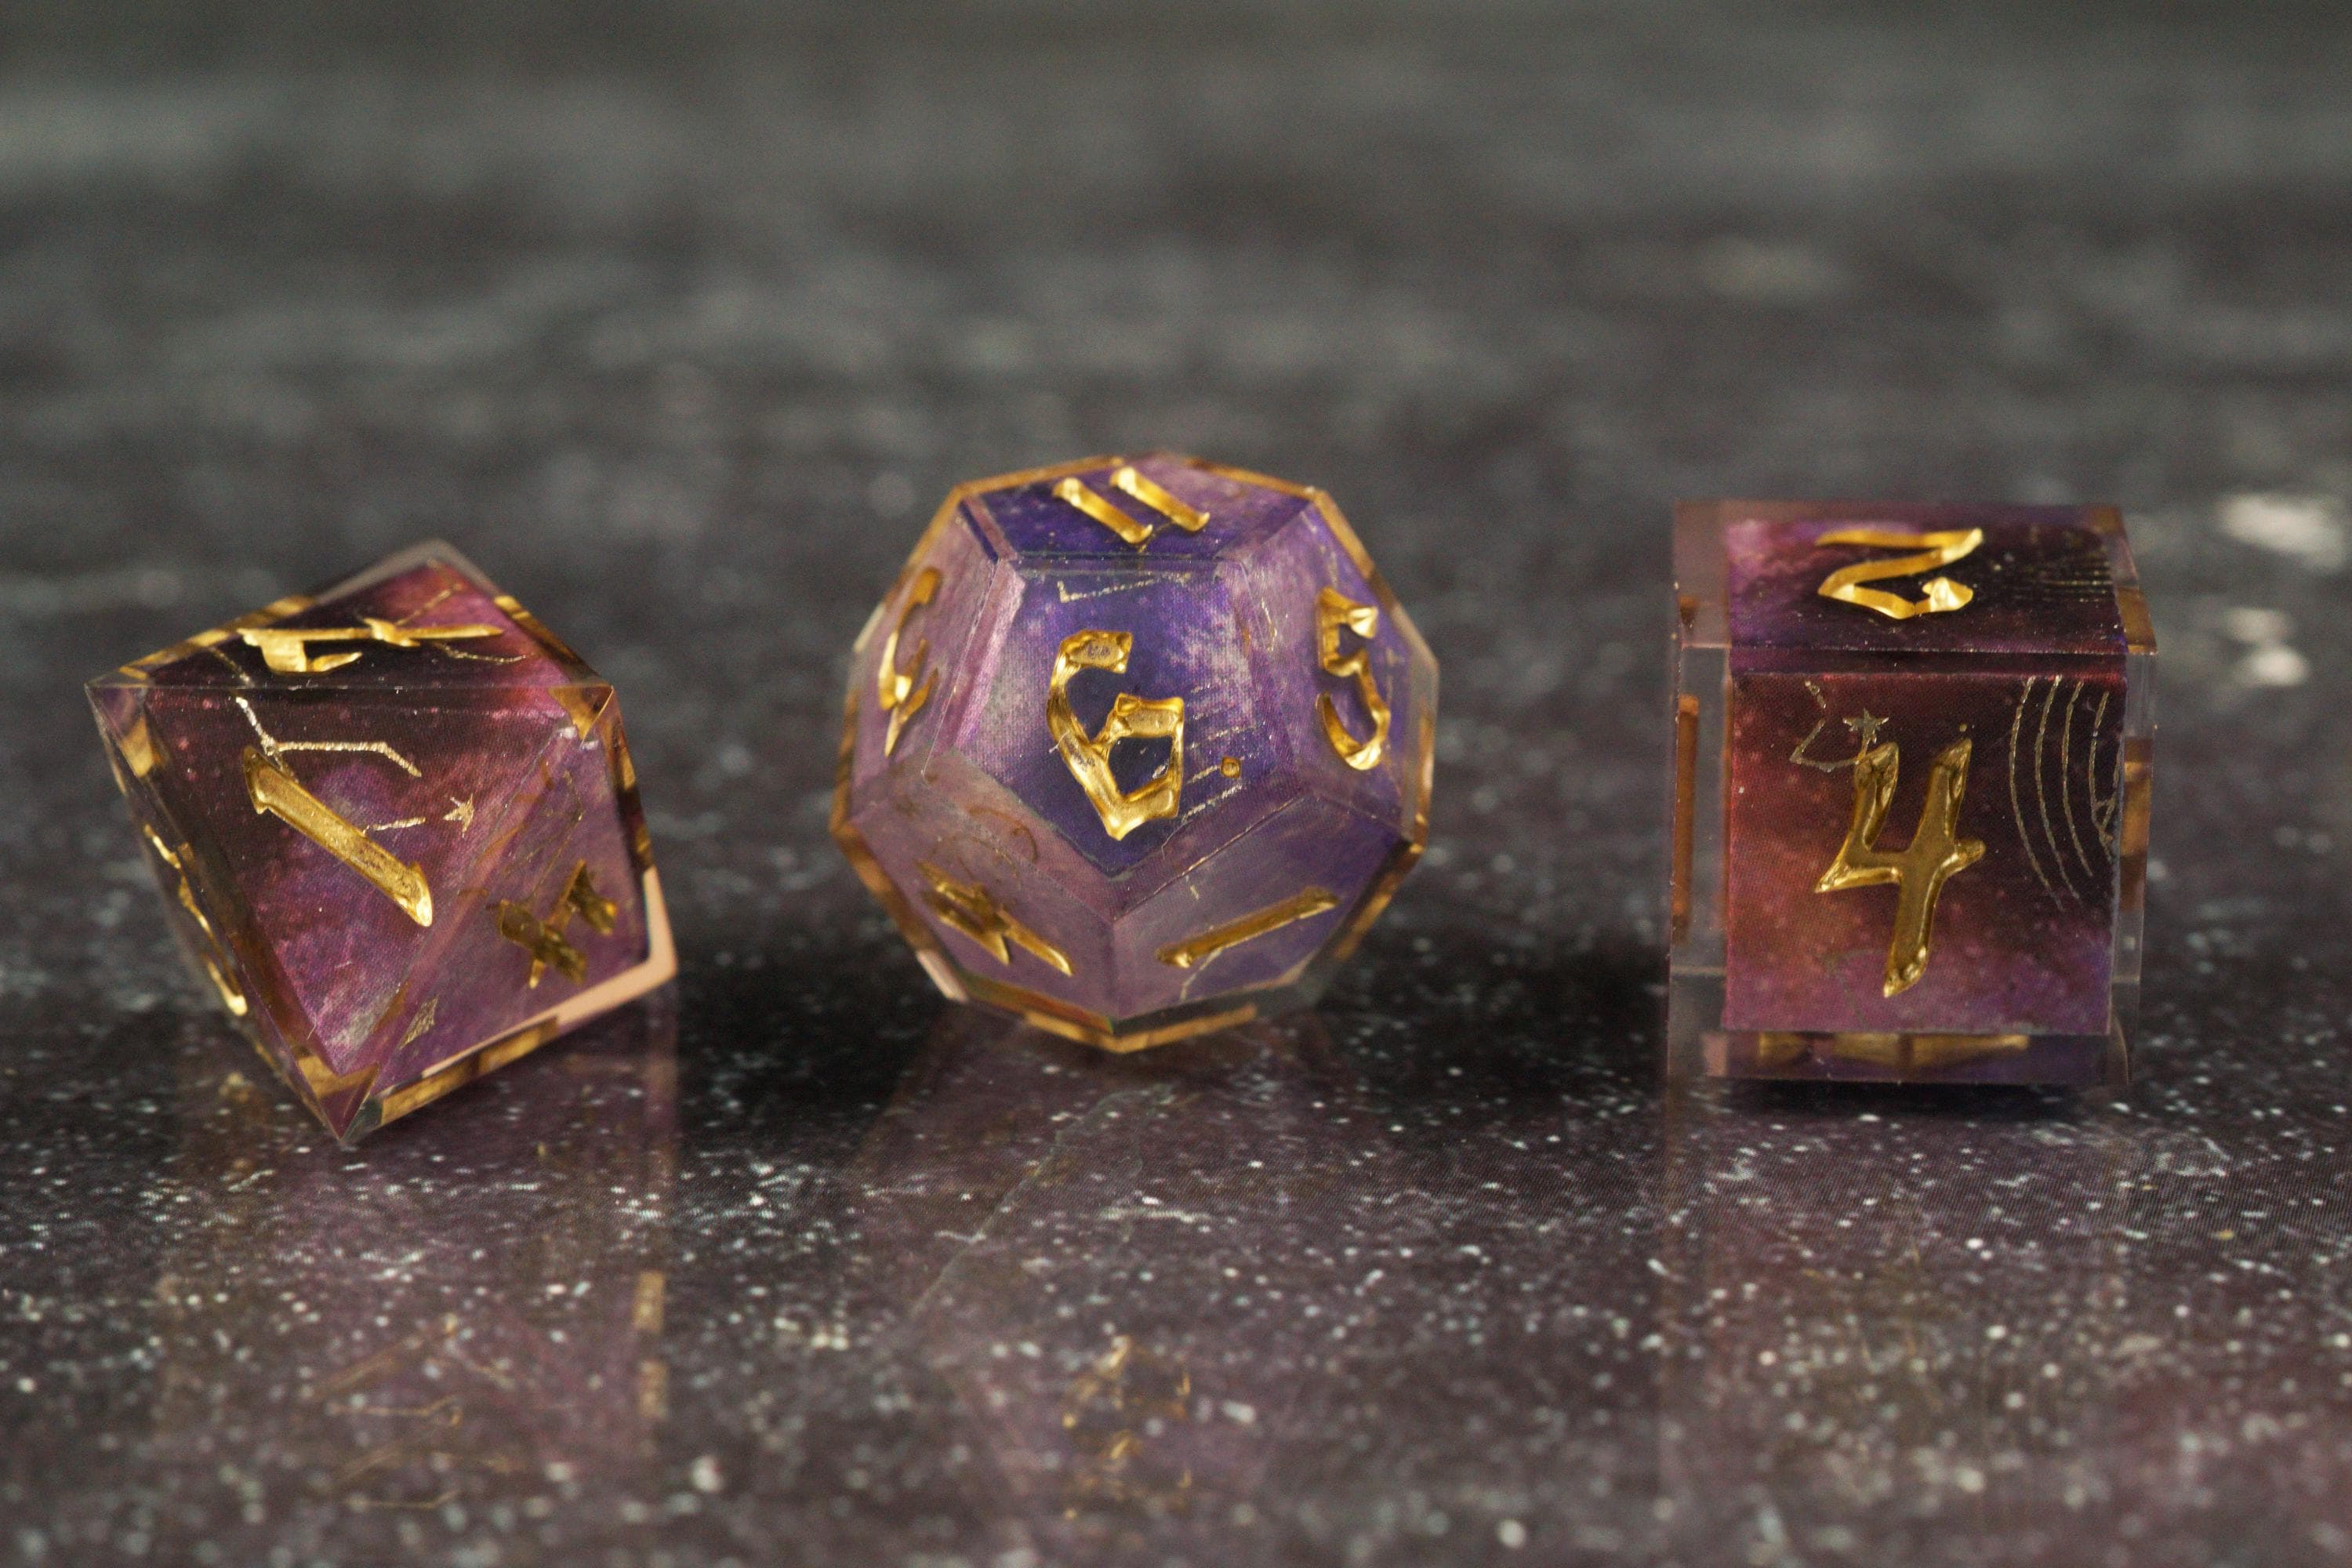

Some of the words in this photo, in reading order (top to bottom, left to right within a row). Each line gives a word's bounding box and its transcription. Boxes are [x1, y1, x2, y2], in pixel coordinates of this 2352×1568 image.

[1816, 528, 1984, 619] 2
[1315, 586, 1390, 771] 5
[243, 744, 434, 927] 1
[1814, 739, 1987, 999] 4
